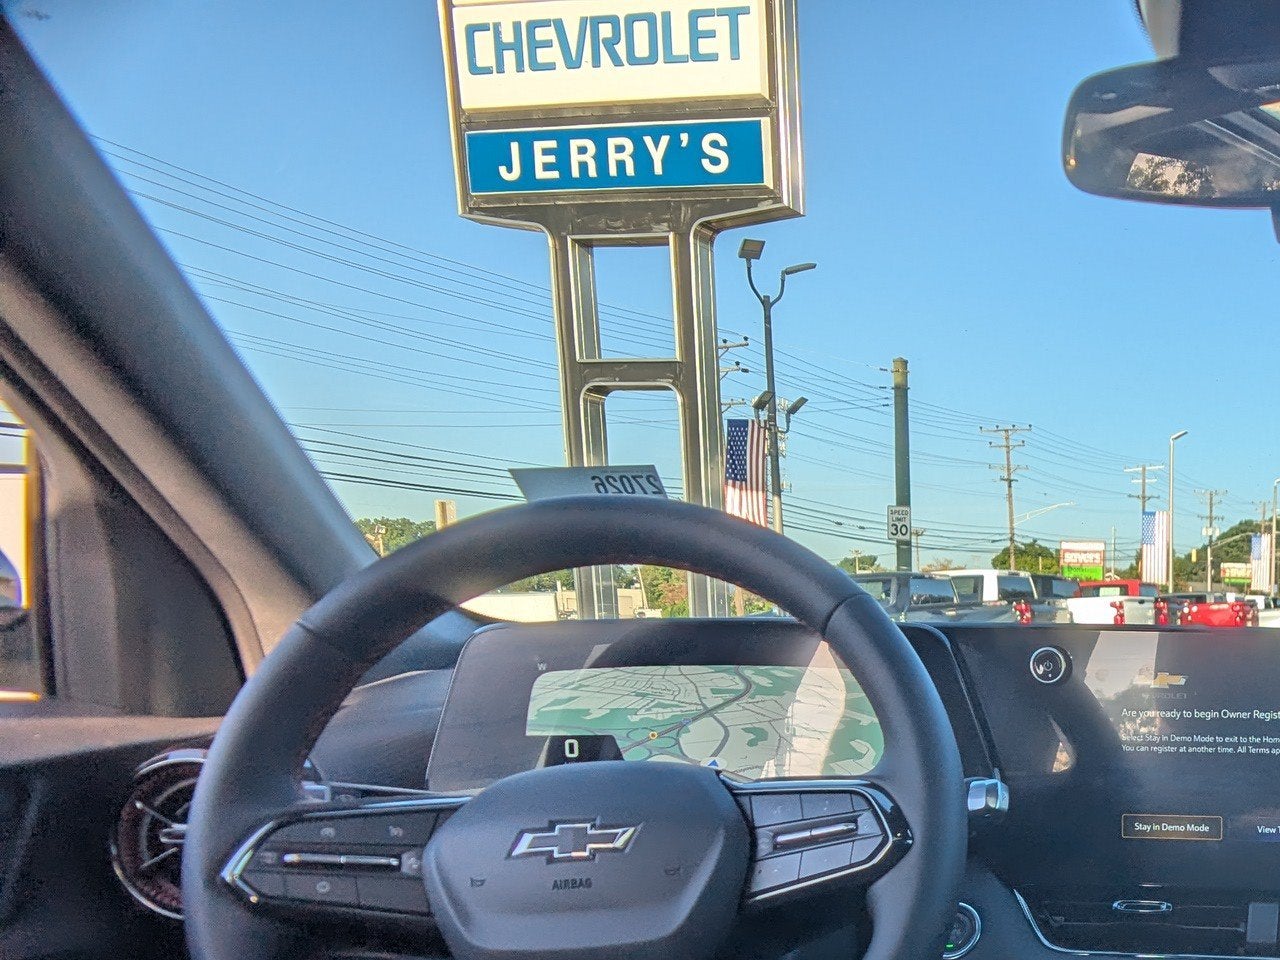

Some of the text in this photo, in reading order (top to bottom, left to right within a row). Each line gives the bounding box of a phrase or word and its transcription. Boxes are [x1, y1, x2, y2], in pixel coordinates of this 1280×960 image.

[464, 6, 750, 76] CHEVROLET
[498, 132, 730, 182] JERRY'S
[891, 523, 908, 536] 30
[1121, 709, 1137, 718] Are
[1138, 711, 1155, 721] you
[1157, 709, 1181, 721] ready
[1183, 710, 1192, 718] to
[1194, 709, 1219, 720] begin
[1221, 711, 1251, 719] Owner
[1121, 734, 1143, 742] Select
[1145, 735, 1161, 744] Stay
[1193, 735, 1214, 743] Mode
[564, 738, 579, 758] 0
[1150, 745, 1177, 754] register
[1134, 823, 1210, 833] Stay in Demo Mode
[1257, 826, 1276, 834] View
[552, 878, 593, 890] AIRBAG
